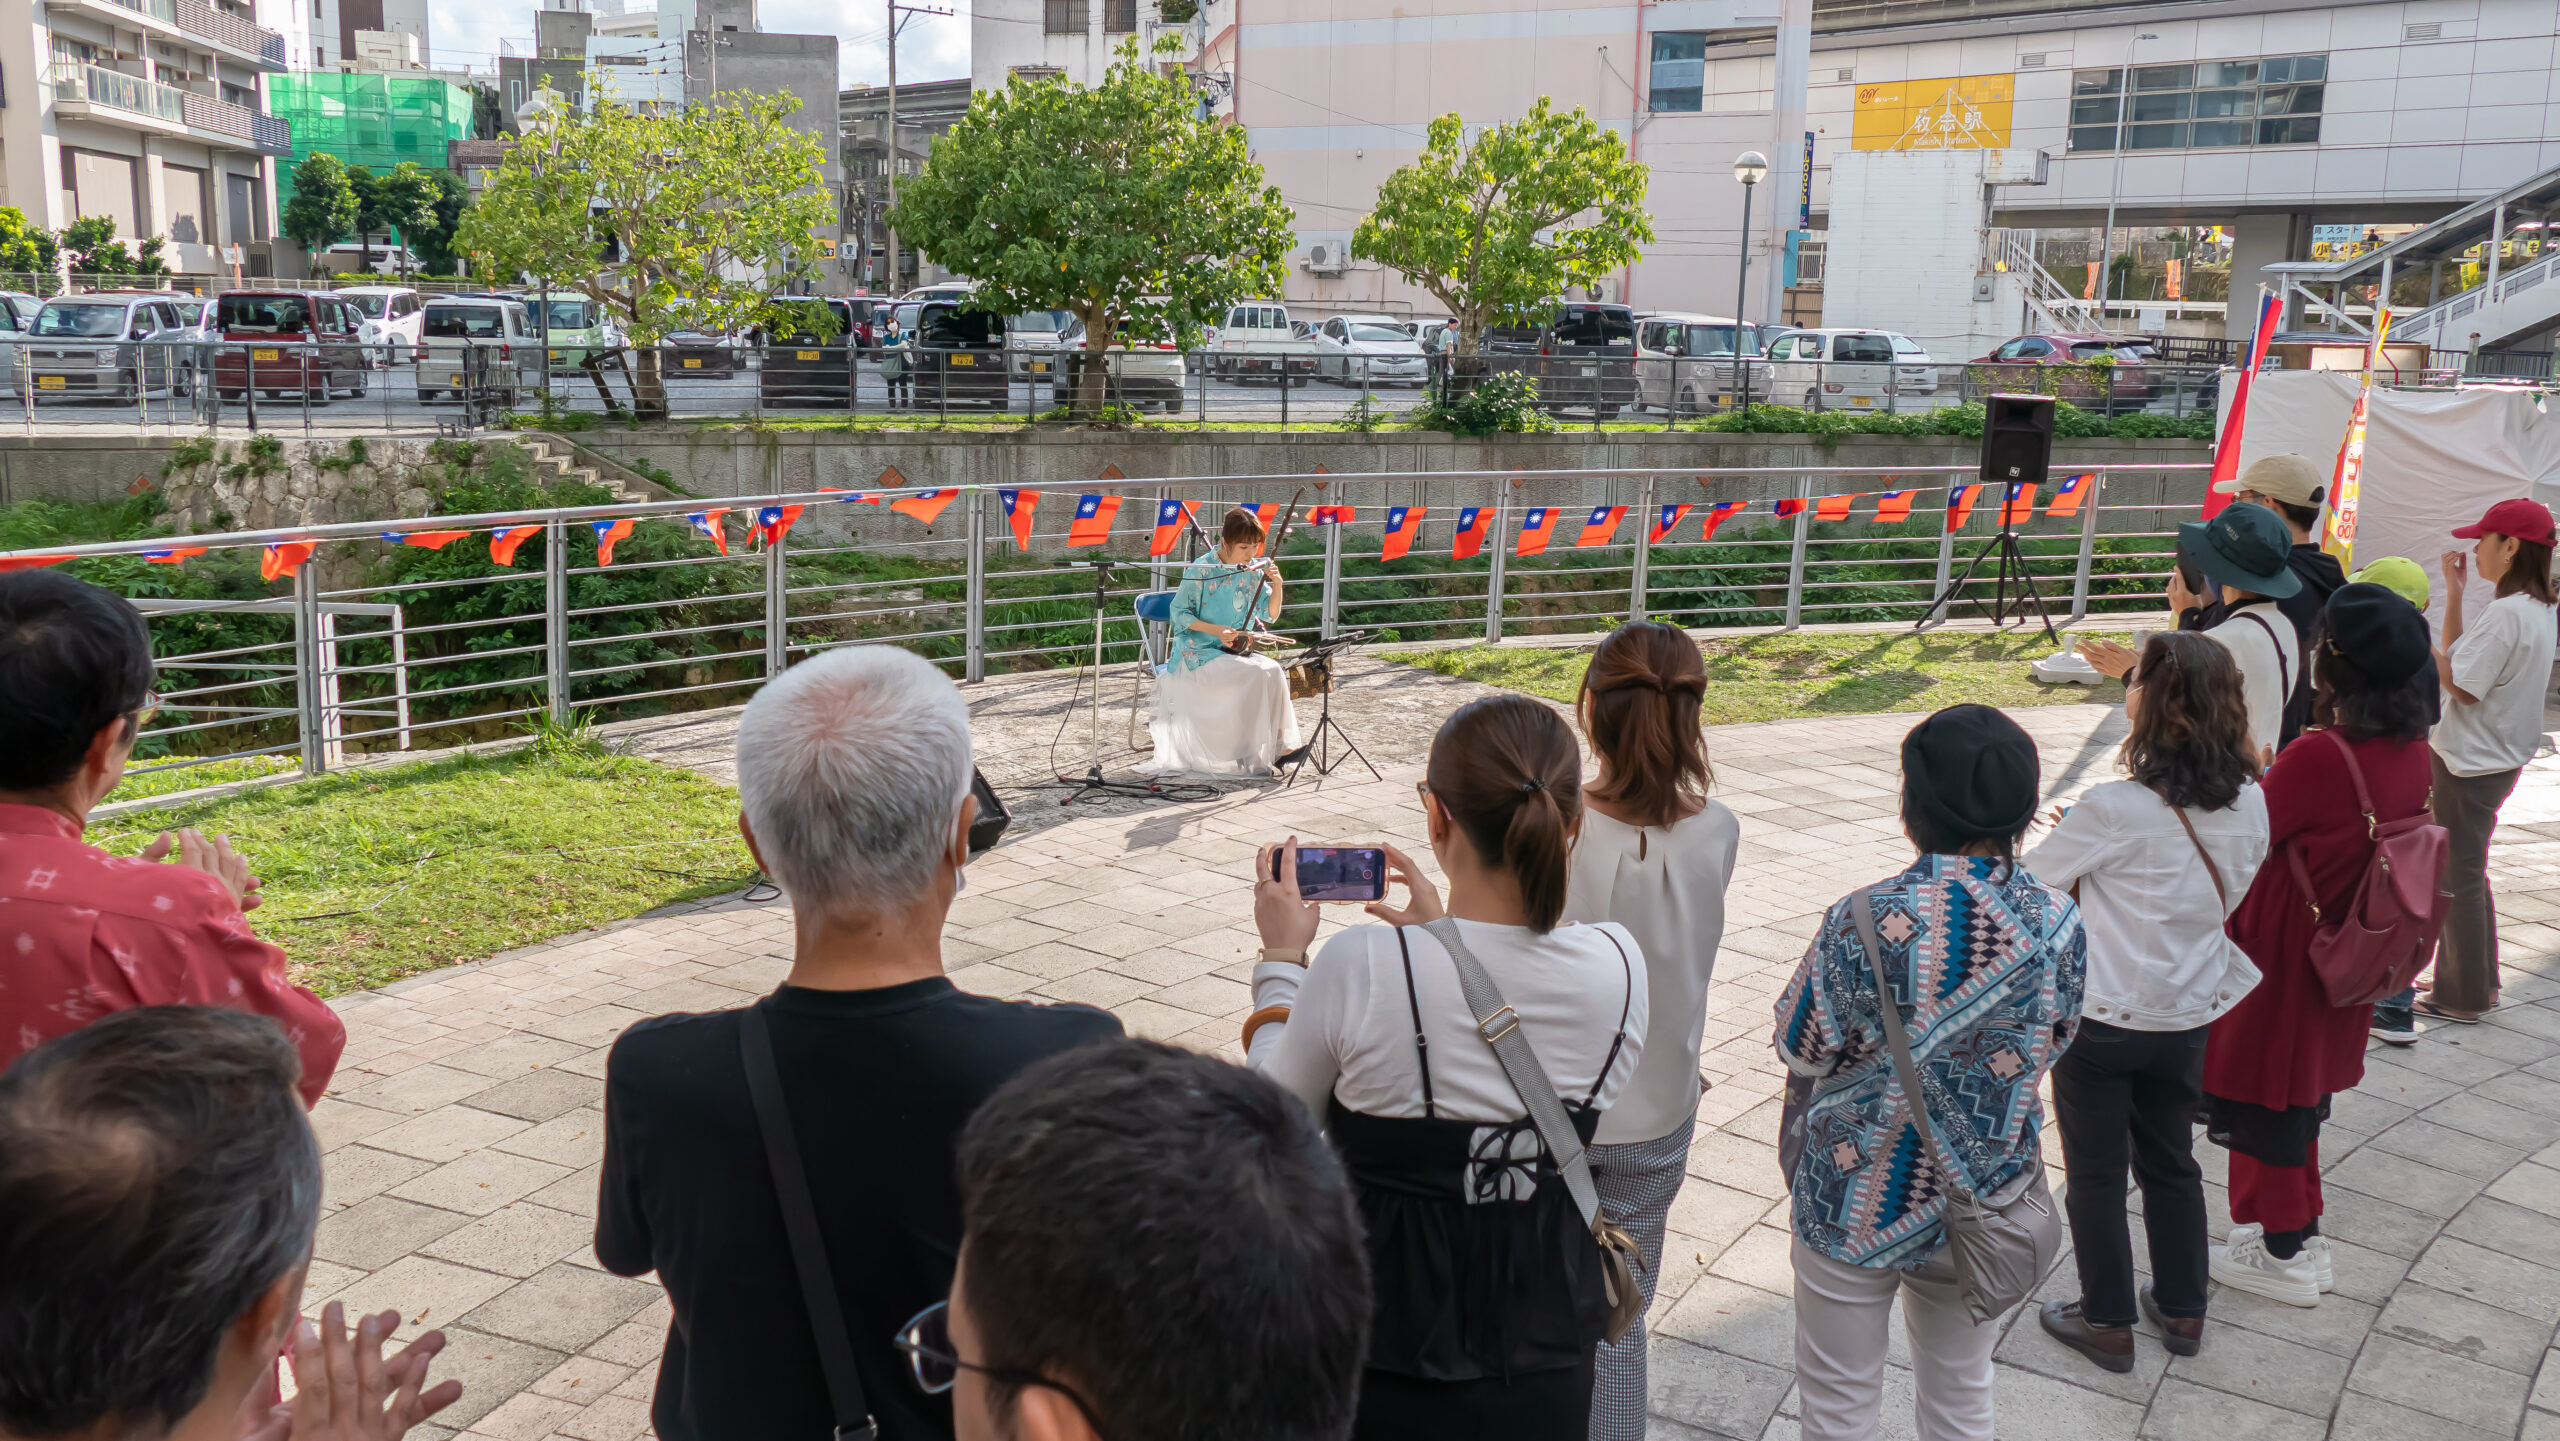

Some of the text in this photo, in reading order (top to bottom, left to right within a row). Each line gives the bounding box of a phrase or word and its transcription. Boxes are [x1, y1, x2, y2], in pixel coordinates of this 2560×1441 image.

[1914, 111, 1982, 132] 牧志駅
[1914, 137, 1942, 146] Makishi
